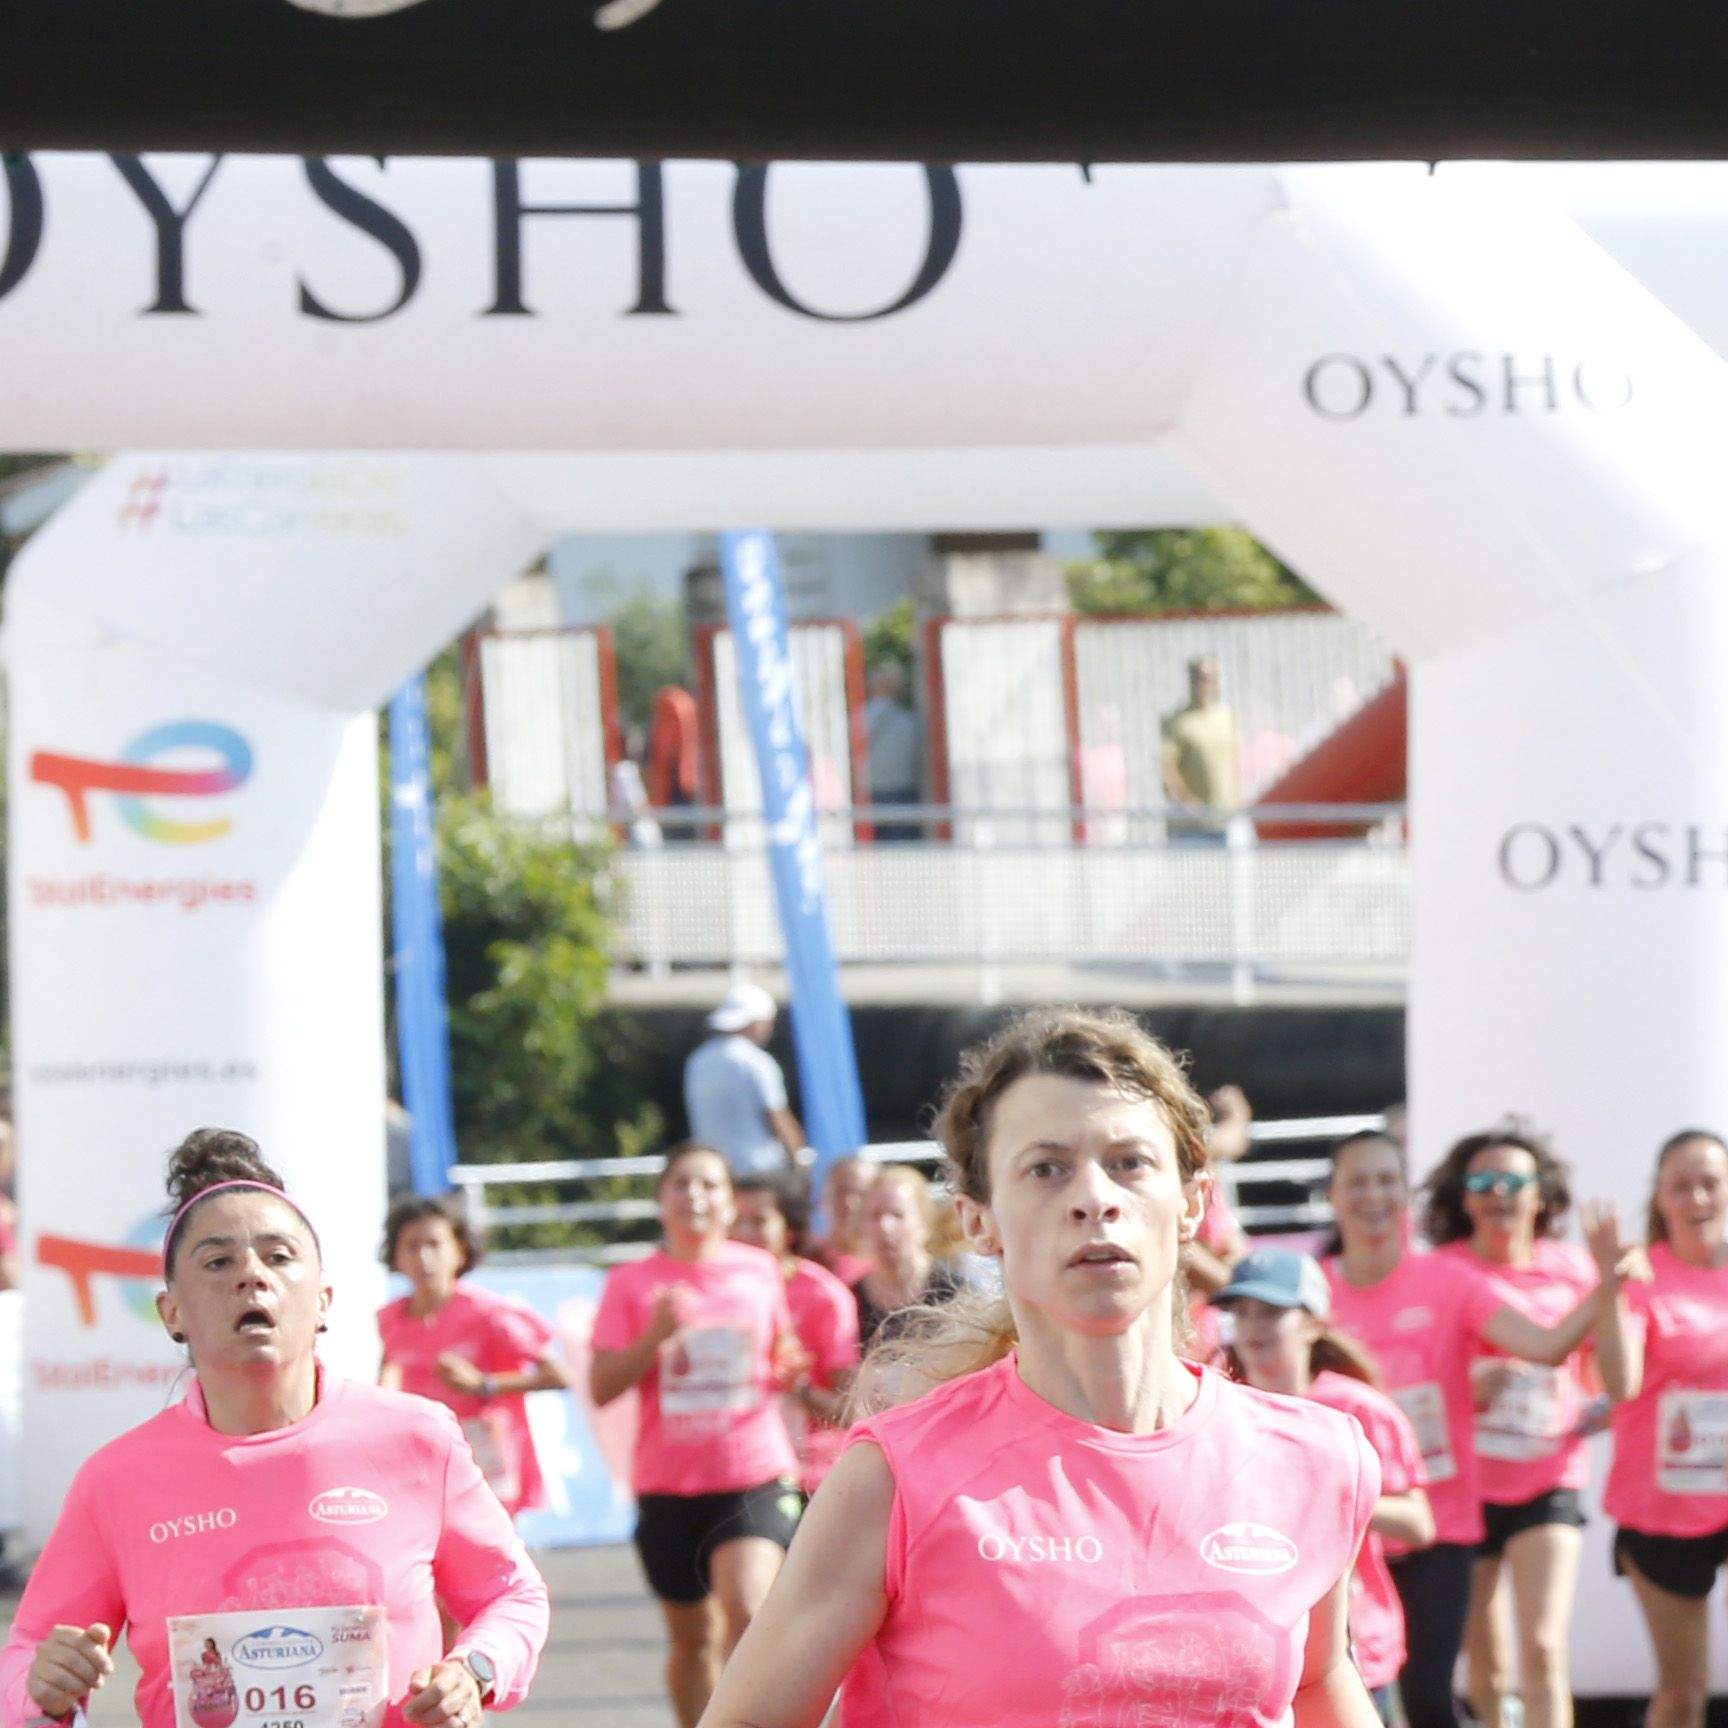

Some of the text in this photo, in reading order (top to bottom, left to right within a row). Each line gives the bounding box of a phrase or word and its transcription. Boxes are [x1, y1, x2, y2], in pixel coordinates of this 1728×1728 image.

[0, 152, 963, 326] YSHO
[1303, 350, 1634, 422] OYSHO
[149, 1507, 237, 1544] OYSHO
[977, 1534, 1103, 1563] OYSHO
[239, 1643, 317, 1661] ASTURIANA
[244, 1684, 317, 1712] 016
